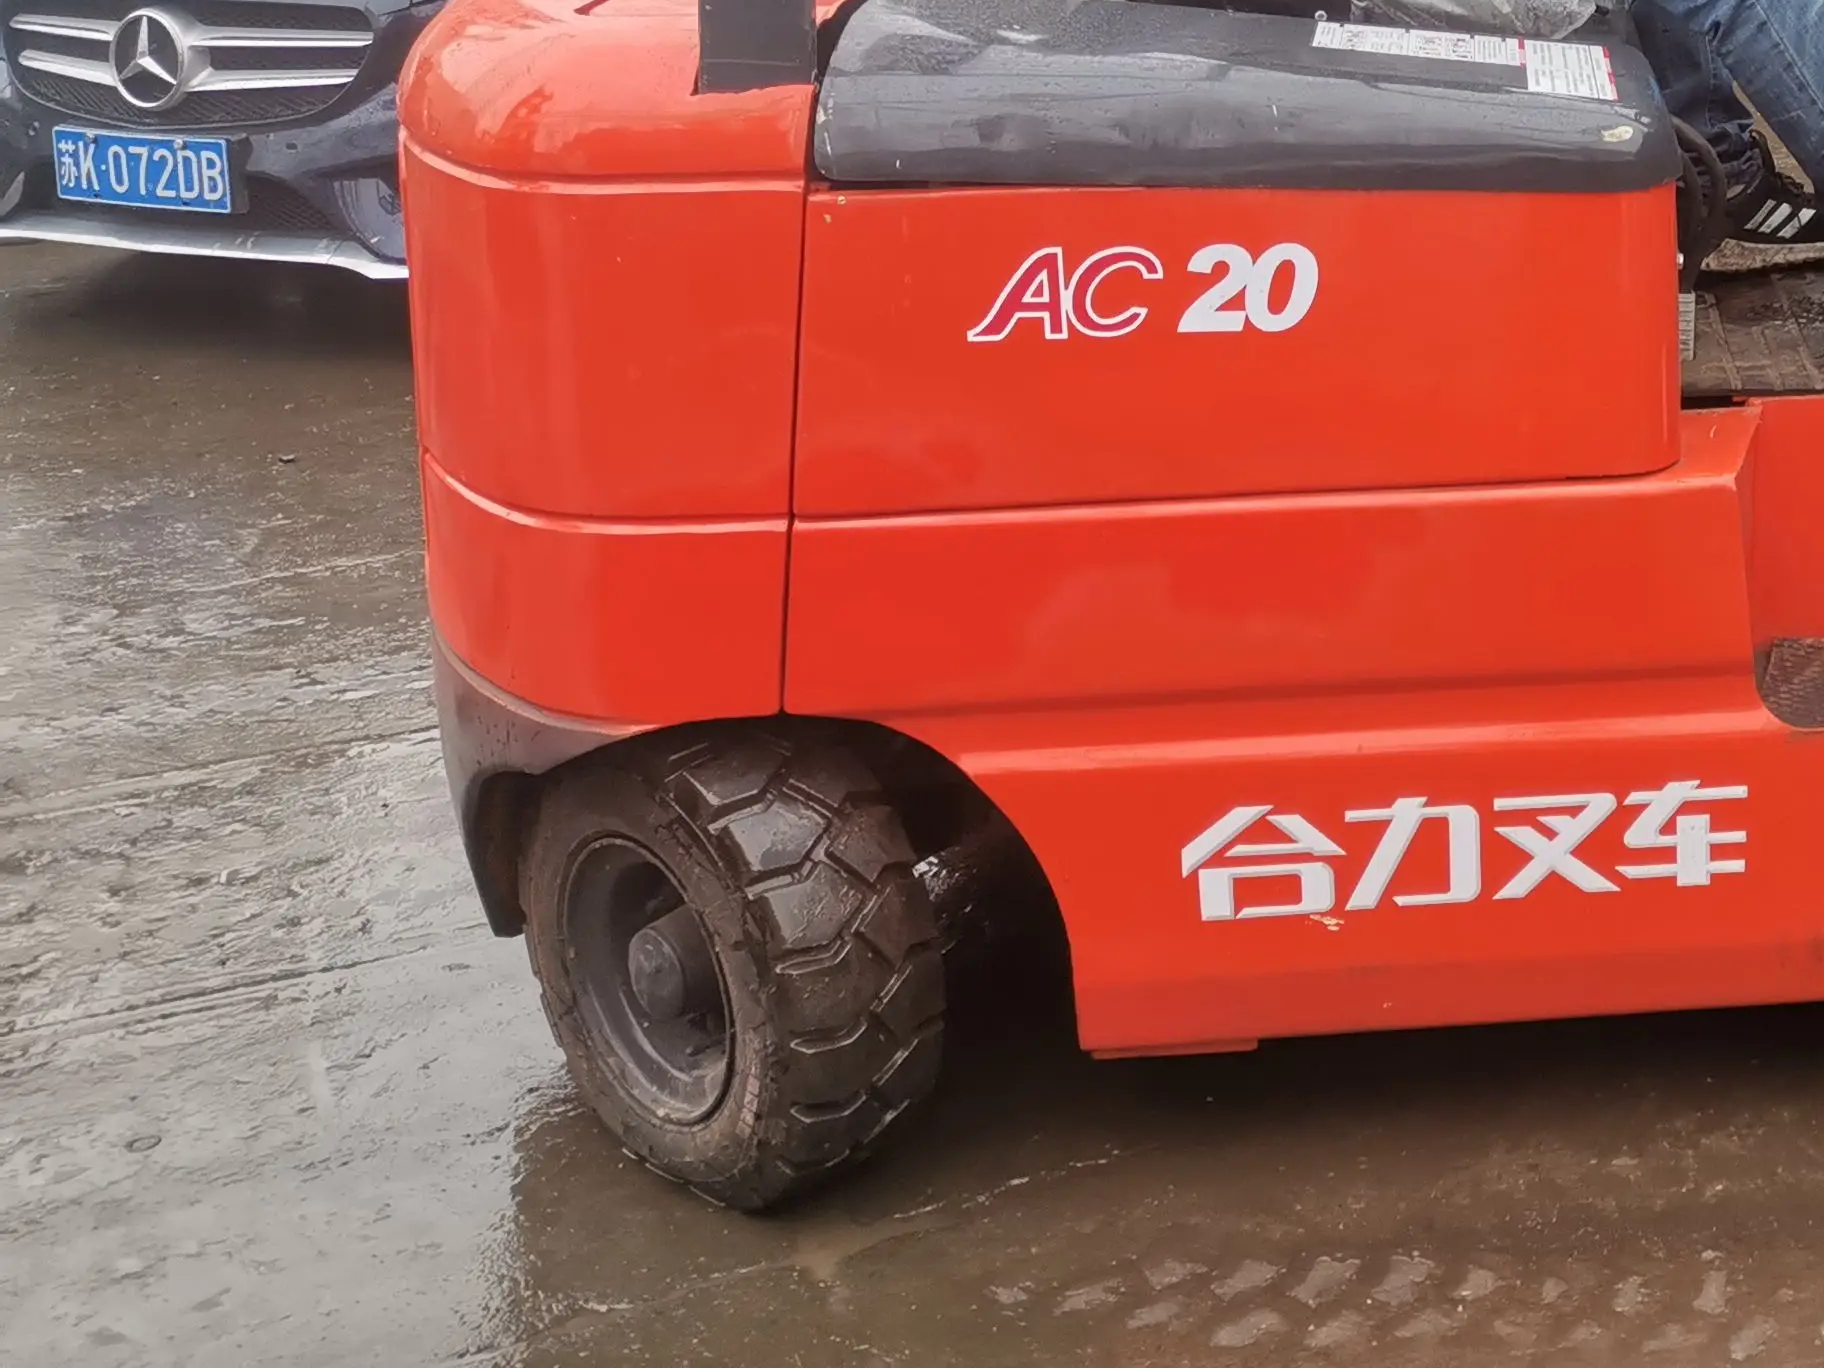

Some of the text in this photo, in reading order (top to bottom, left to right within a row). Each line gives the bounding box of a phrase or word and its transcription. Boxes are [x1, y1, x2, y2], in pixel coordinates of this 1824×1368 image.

[967, 243, 1319, 342] AC 20
[1181, 779, 1748, 922] 合力叉车
